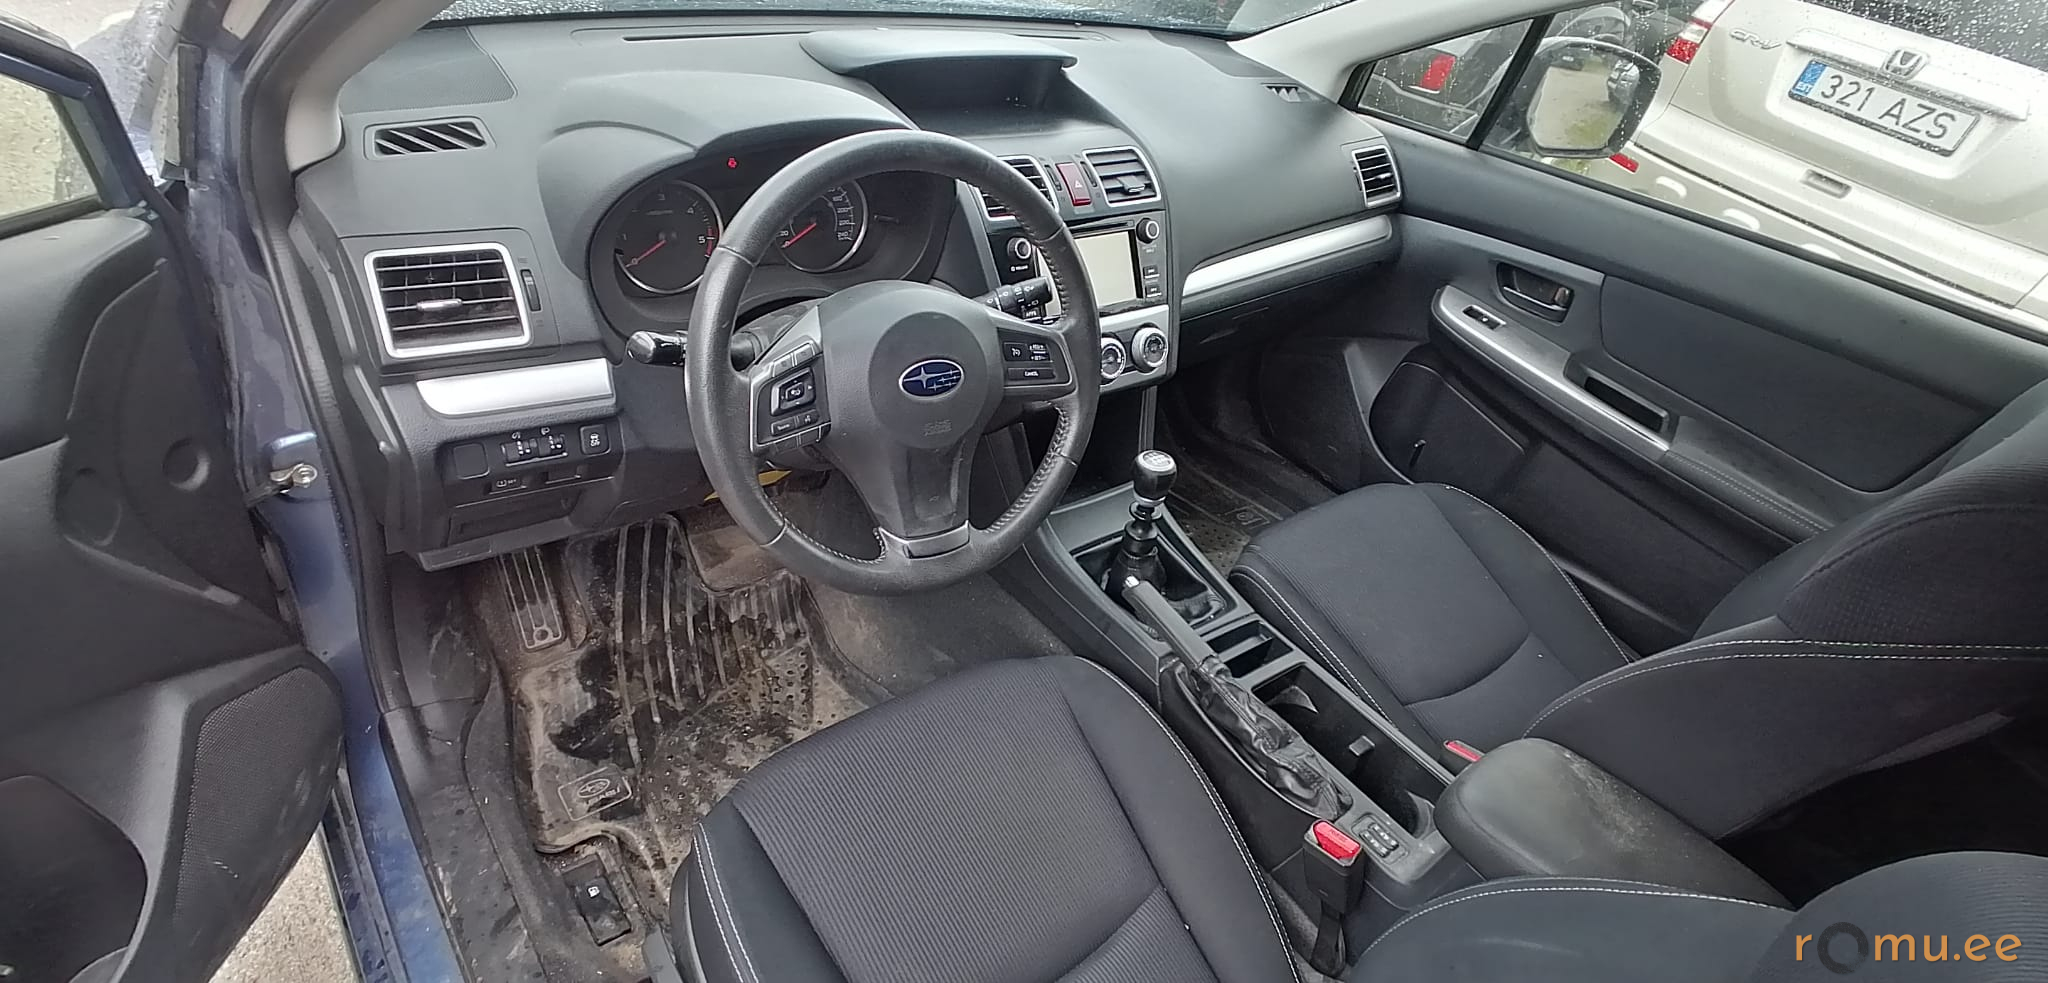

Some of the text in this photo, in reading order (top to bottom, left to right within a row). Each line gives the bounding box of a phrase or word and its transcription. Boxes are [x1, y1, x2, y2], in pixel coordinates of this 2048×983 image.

[1796, 82, 1813, 94] EST
[1821, 74, 1956, 139] 321 AZS
[699, 236, 706, 244] 5
